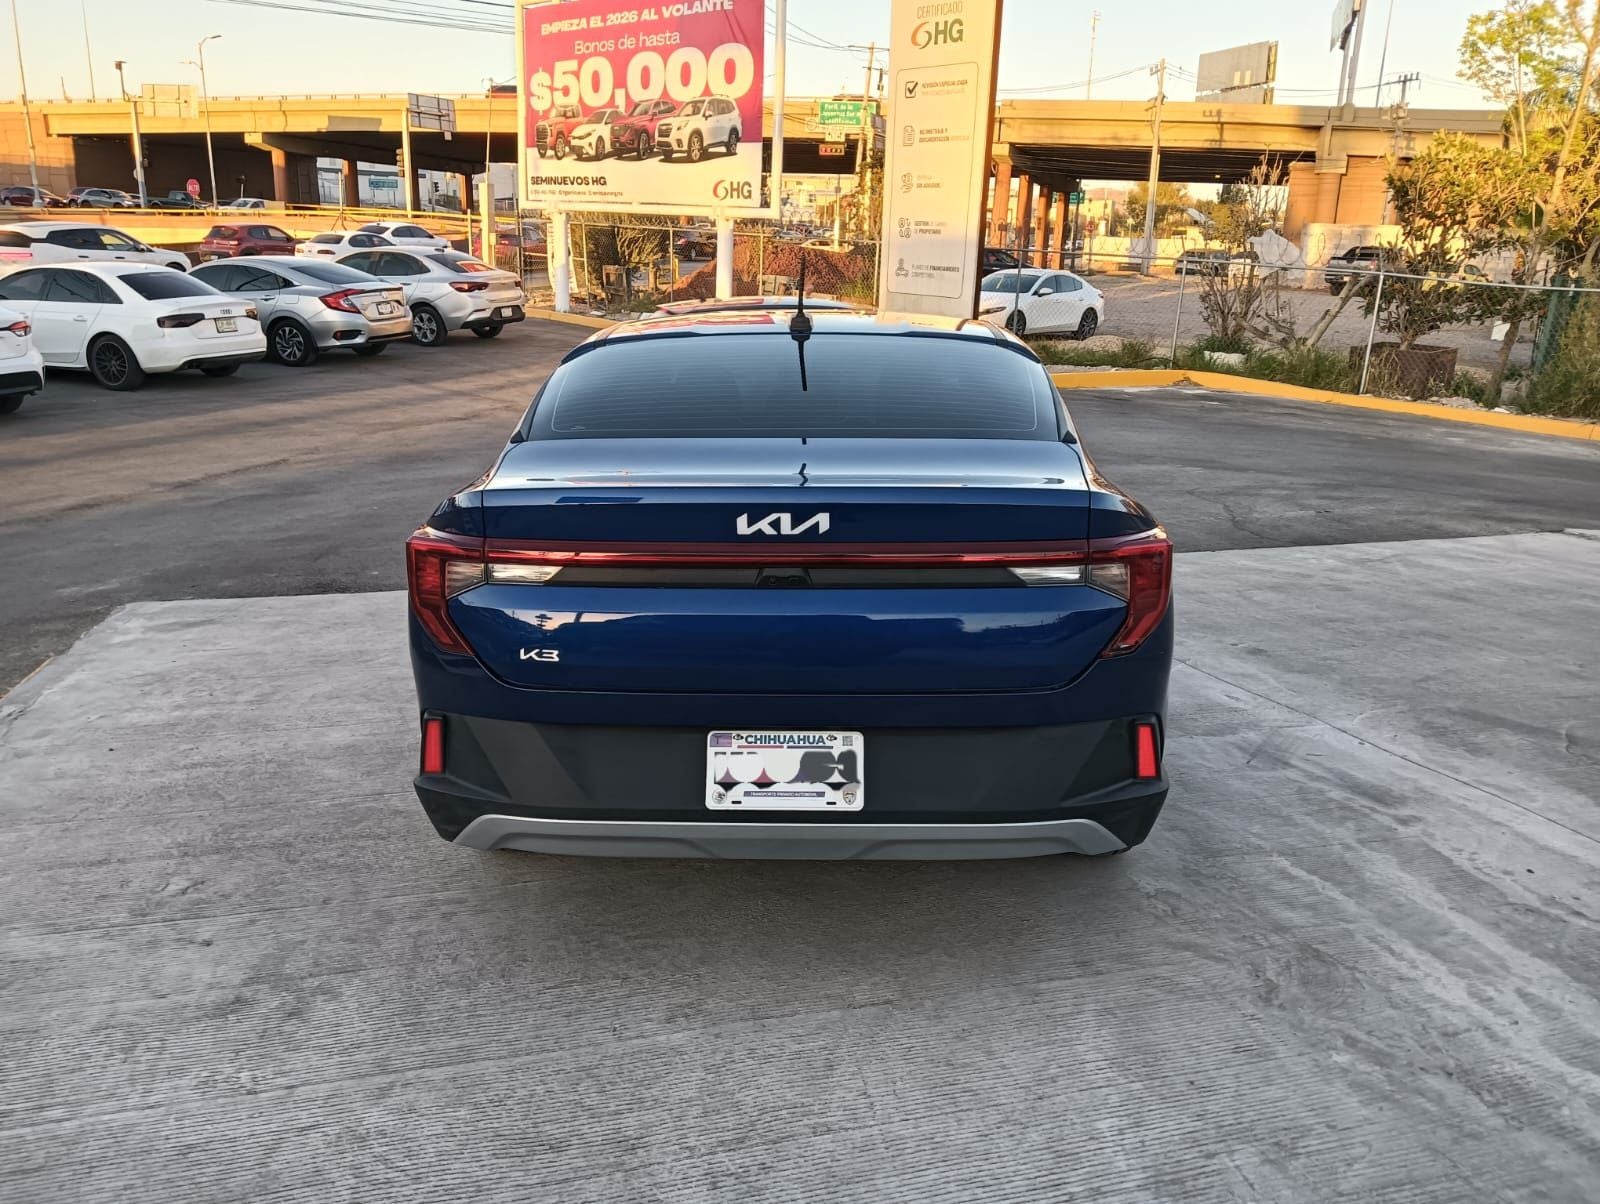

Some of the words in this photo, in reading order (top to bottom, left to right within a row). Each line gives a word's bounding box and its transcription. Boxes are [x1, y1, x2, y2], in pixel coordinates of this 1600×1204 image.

[541, 18, 587, 36] EMPIEZA
[589, 16, 604, 28] EL
[606, 10, 638, 26] 2026
[640, 8, 659, 21] AL
[661, 0, 734, 18] VOLANTE
[916, 1, 963, 19] CERTIFICADO
[933, 18, 964, 45] HG
[574, 40, 615, 55] Bonos
[618, 33, 636, 49] de
[639, 29, 680, 47] hasta
[530, 42, 754, 115] $50,000
[530, 176, 590, 186] SEMINUEVOS
[591, 176, 607, 186] HG
[730, 181, 752, 199] HG
[519, 648, 560, 662] K3
[744, 734, 826, 745] CHIHUAHUA
